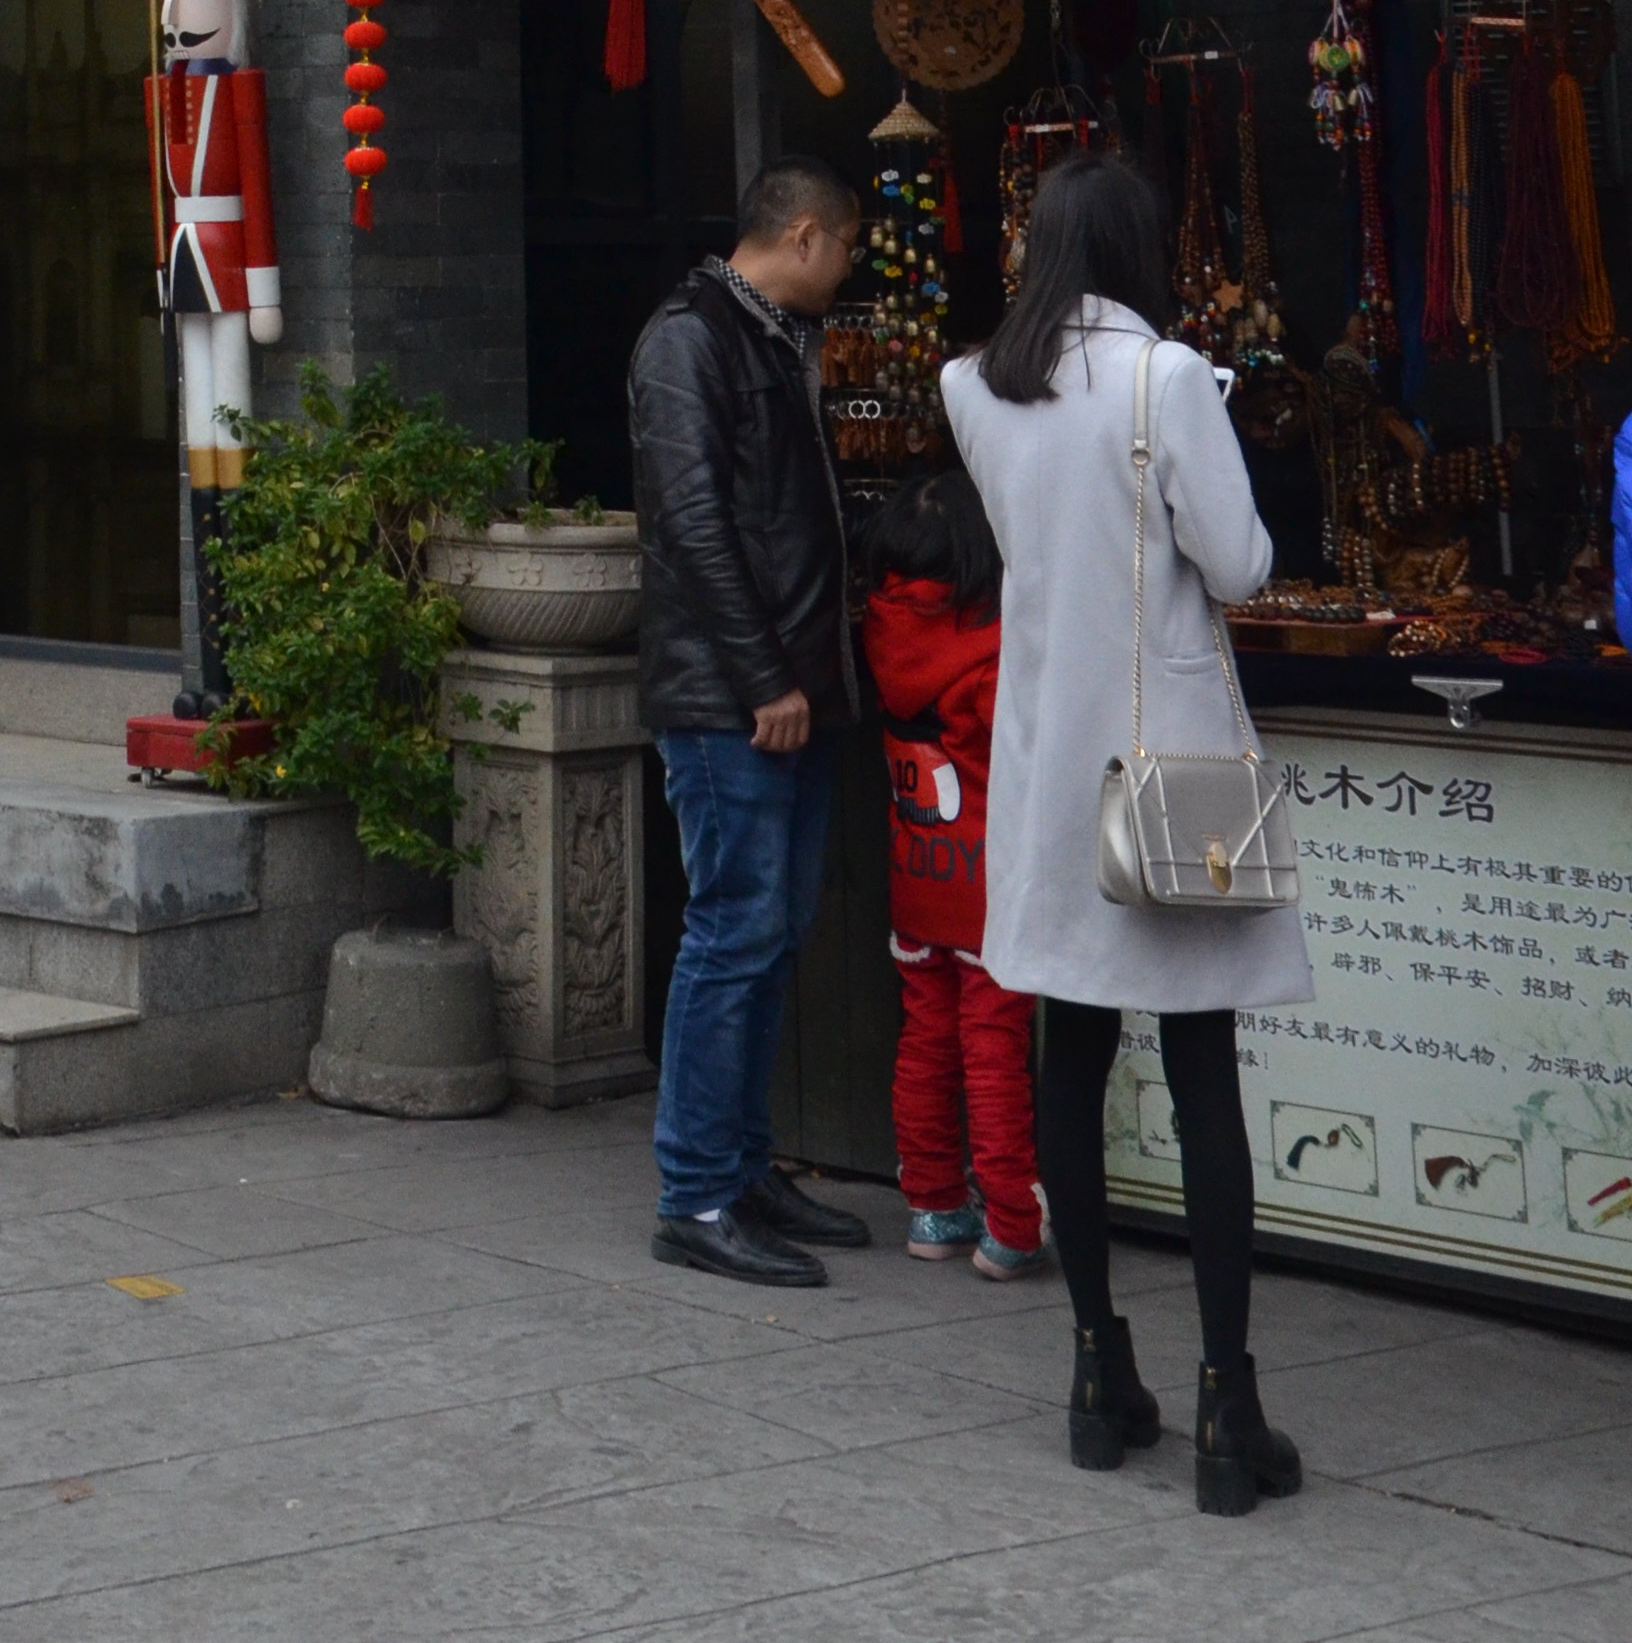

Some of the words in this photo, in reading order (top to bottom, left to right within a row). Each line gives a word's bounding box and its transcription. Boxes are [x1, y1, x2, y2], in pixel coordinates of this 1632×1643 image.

[896, 758, 919, 793] 10
[1294, 838, 1632, 893] 文化和信仰上有极其重要的
